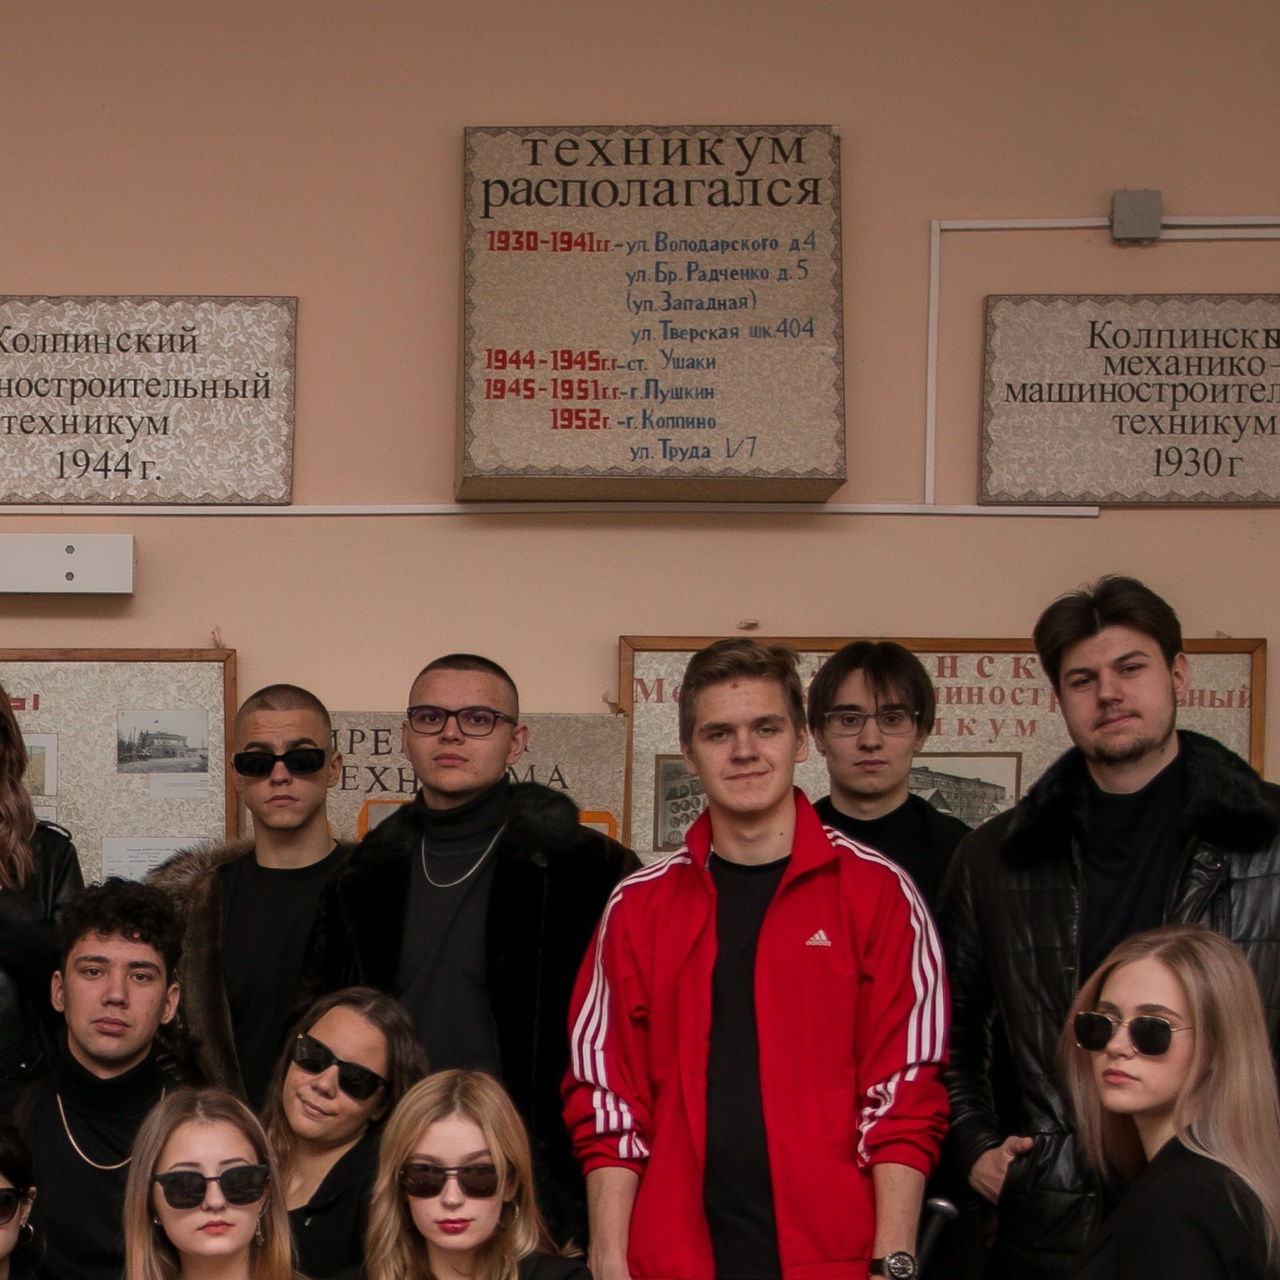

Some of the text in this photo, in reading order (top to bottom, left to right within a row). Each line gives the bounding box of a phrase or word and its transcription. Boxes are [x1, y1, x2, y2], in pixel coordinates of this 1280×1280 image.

[520, 135, 807, 177] техникум
[479, 175, 823, 220] располагался
[655, 230, 778, 255] Володарского
[626, 269, 651, 286] ул.
[655, 261, 682, 285] Бр.
[687, 261, 769, 284] Радченко
[630, 327, 656, 345] ул.
[660, 320, 739, 343] Тверская
[660, 348, 716, 371] Ушаки
[0, 414, 170, 443] техникум
[642, 408, 717, 430] Колпино
[1112, 414, 1278, 444] техникум
[630, 446, 654, 462] ул.
[658, 438, 711, 462] Труда
[1152, 446, 1222, 477] 1930
[56, 450, 162, 481] 1944 г.
